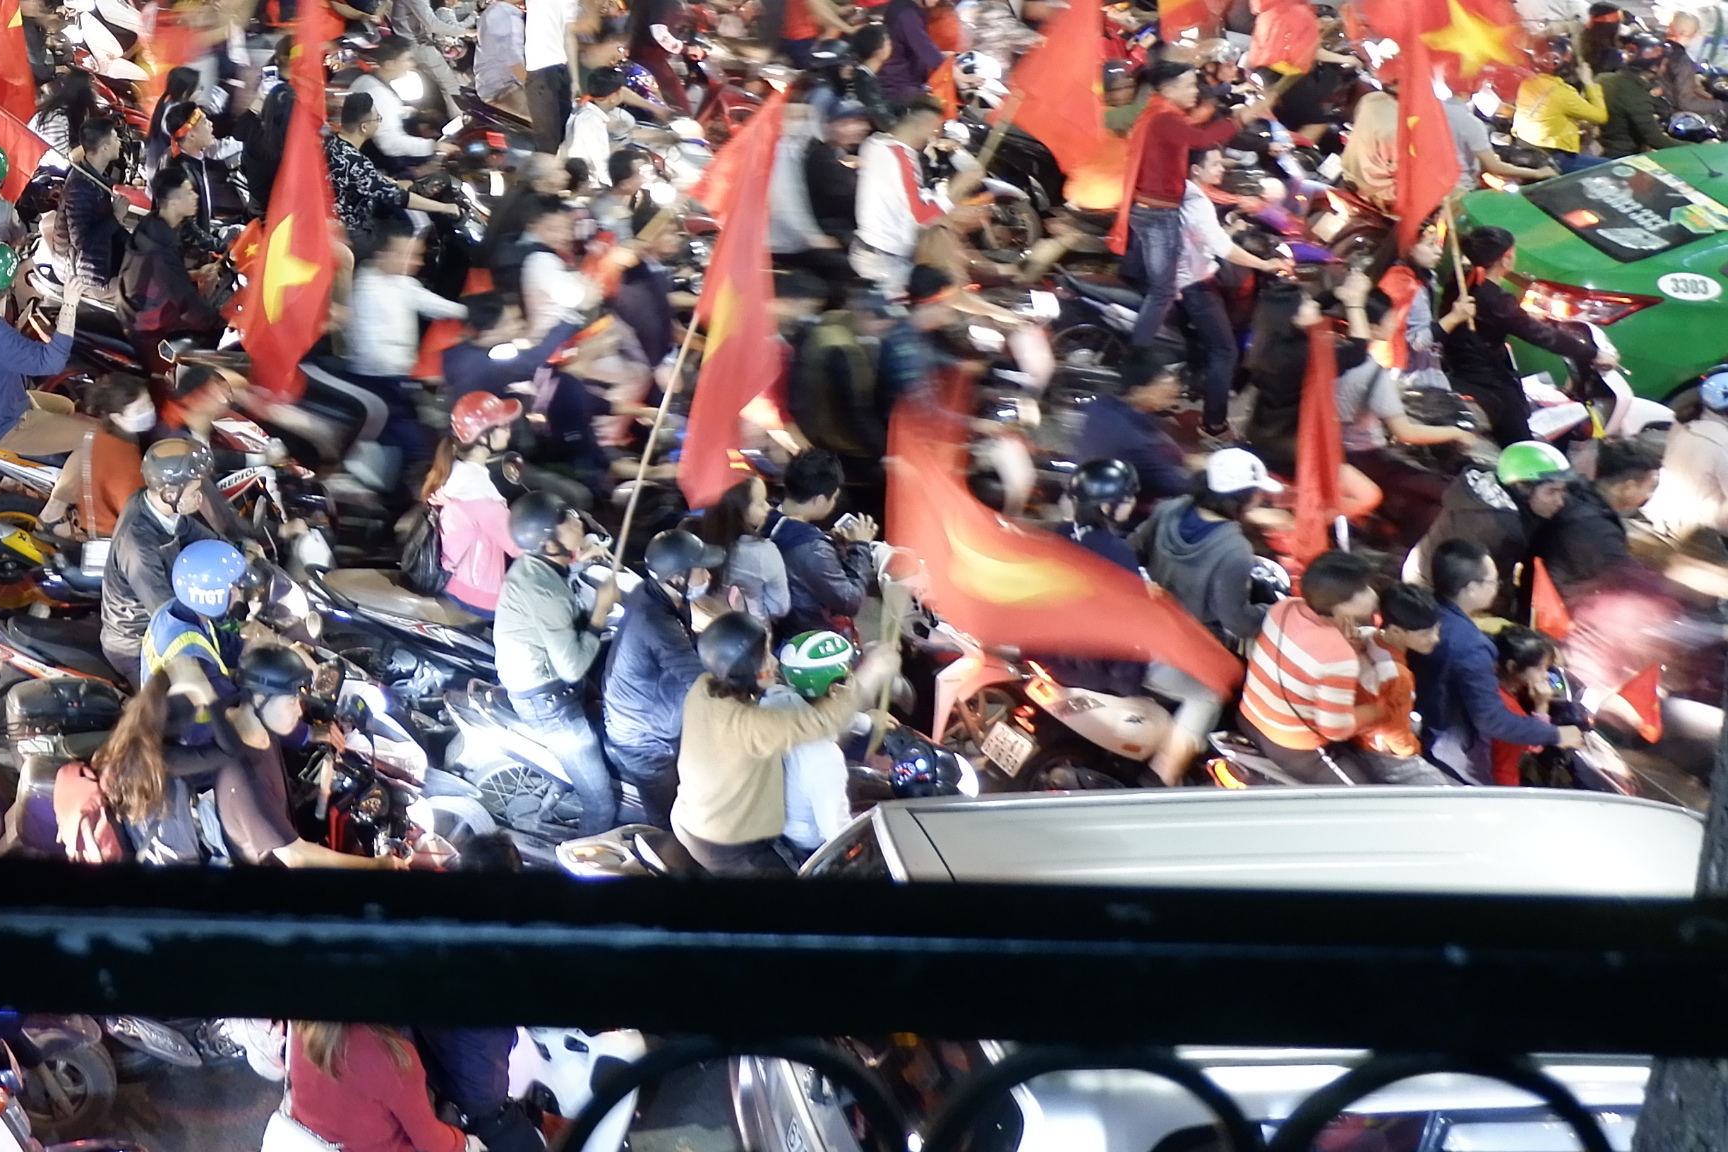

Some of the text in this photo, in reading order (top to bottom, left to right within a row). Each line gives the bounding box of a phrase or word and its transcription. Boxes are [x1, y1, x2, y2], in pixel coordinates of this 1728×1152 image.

[1669, 277, 1709, 295] 3303
[220, 466, 259, 489] REPSOL
[188, 586, 225, 605] TTGT
